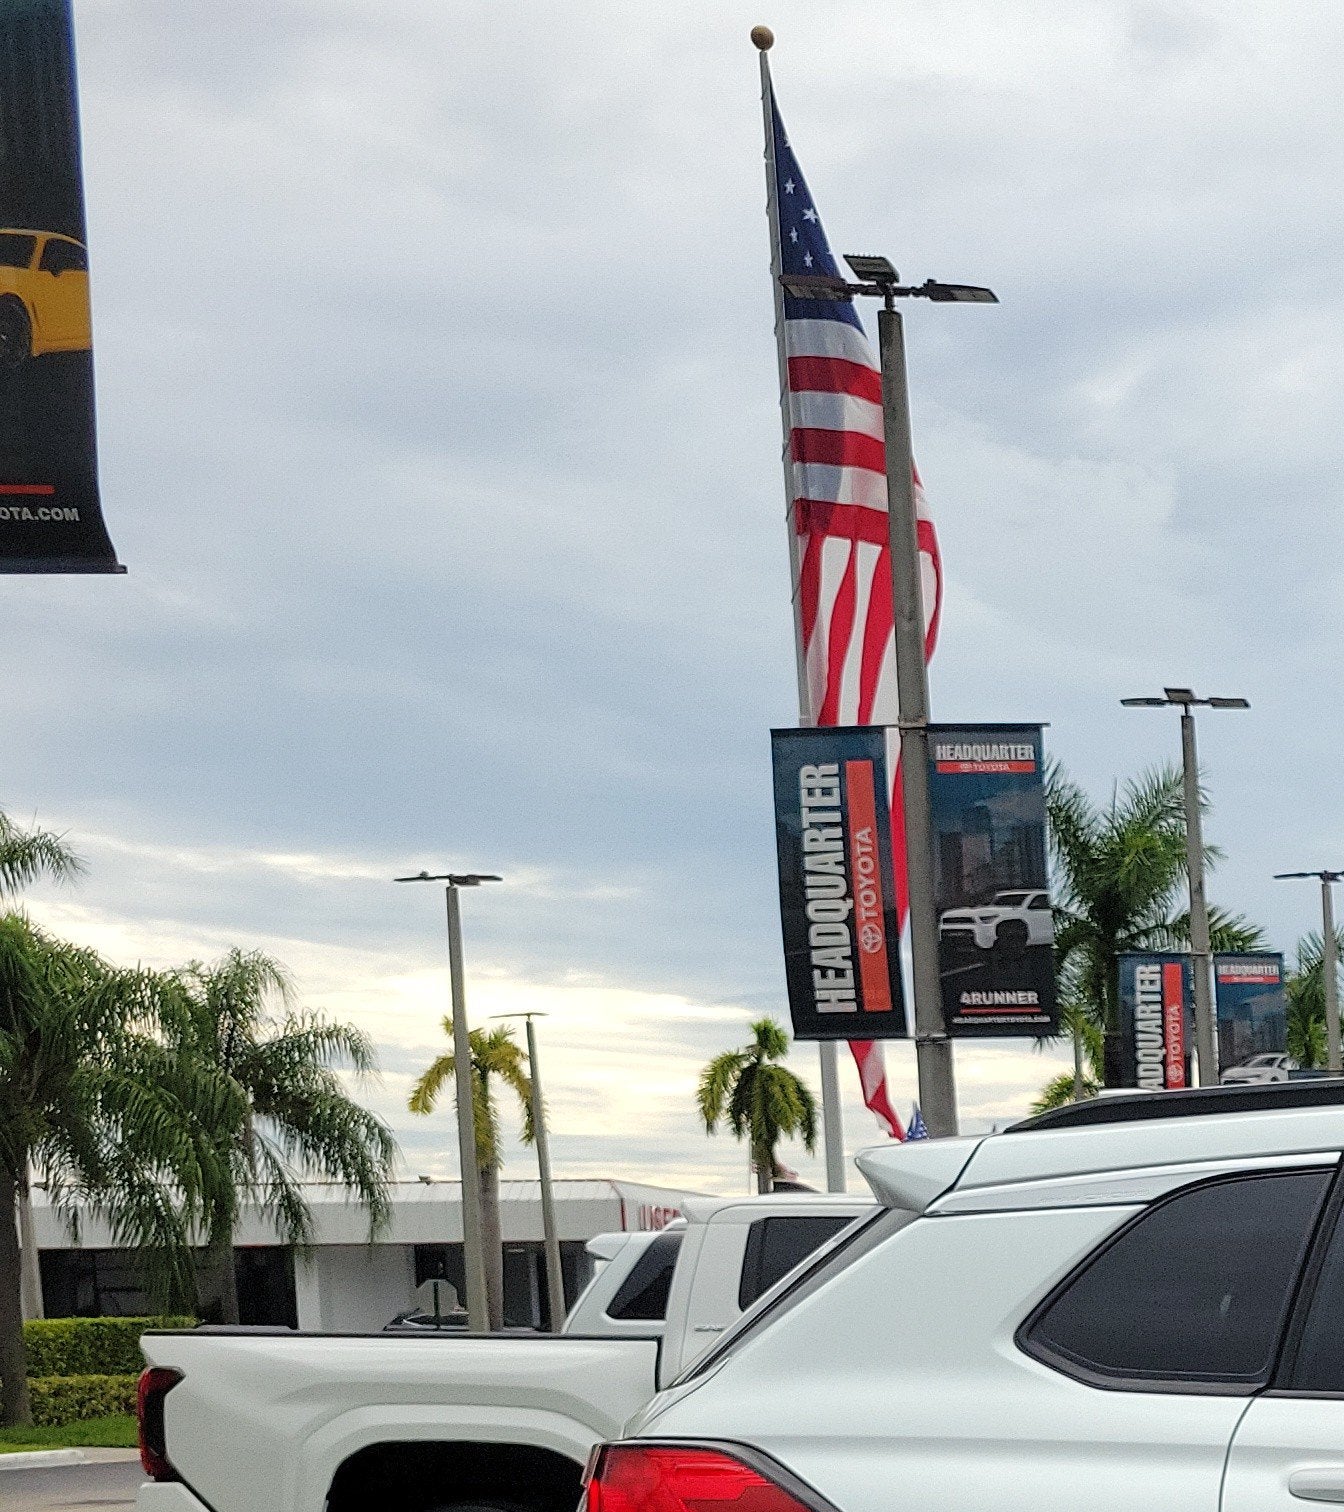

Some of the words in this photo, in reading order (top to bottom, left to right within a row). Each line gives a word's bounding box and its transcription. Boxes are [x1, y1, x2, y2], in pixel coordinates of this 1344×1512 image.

[936, 745, 1035, 761] HEADQUARTER
[800, 763, 857, 1013] HEADQUARTER
[853, 826, 877, 921] TOYOTA
[960, 991, 1040, 1004] 4RUNNER
